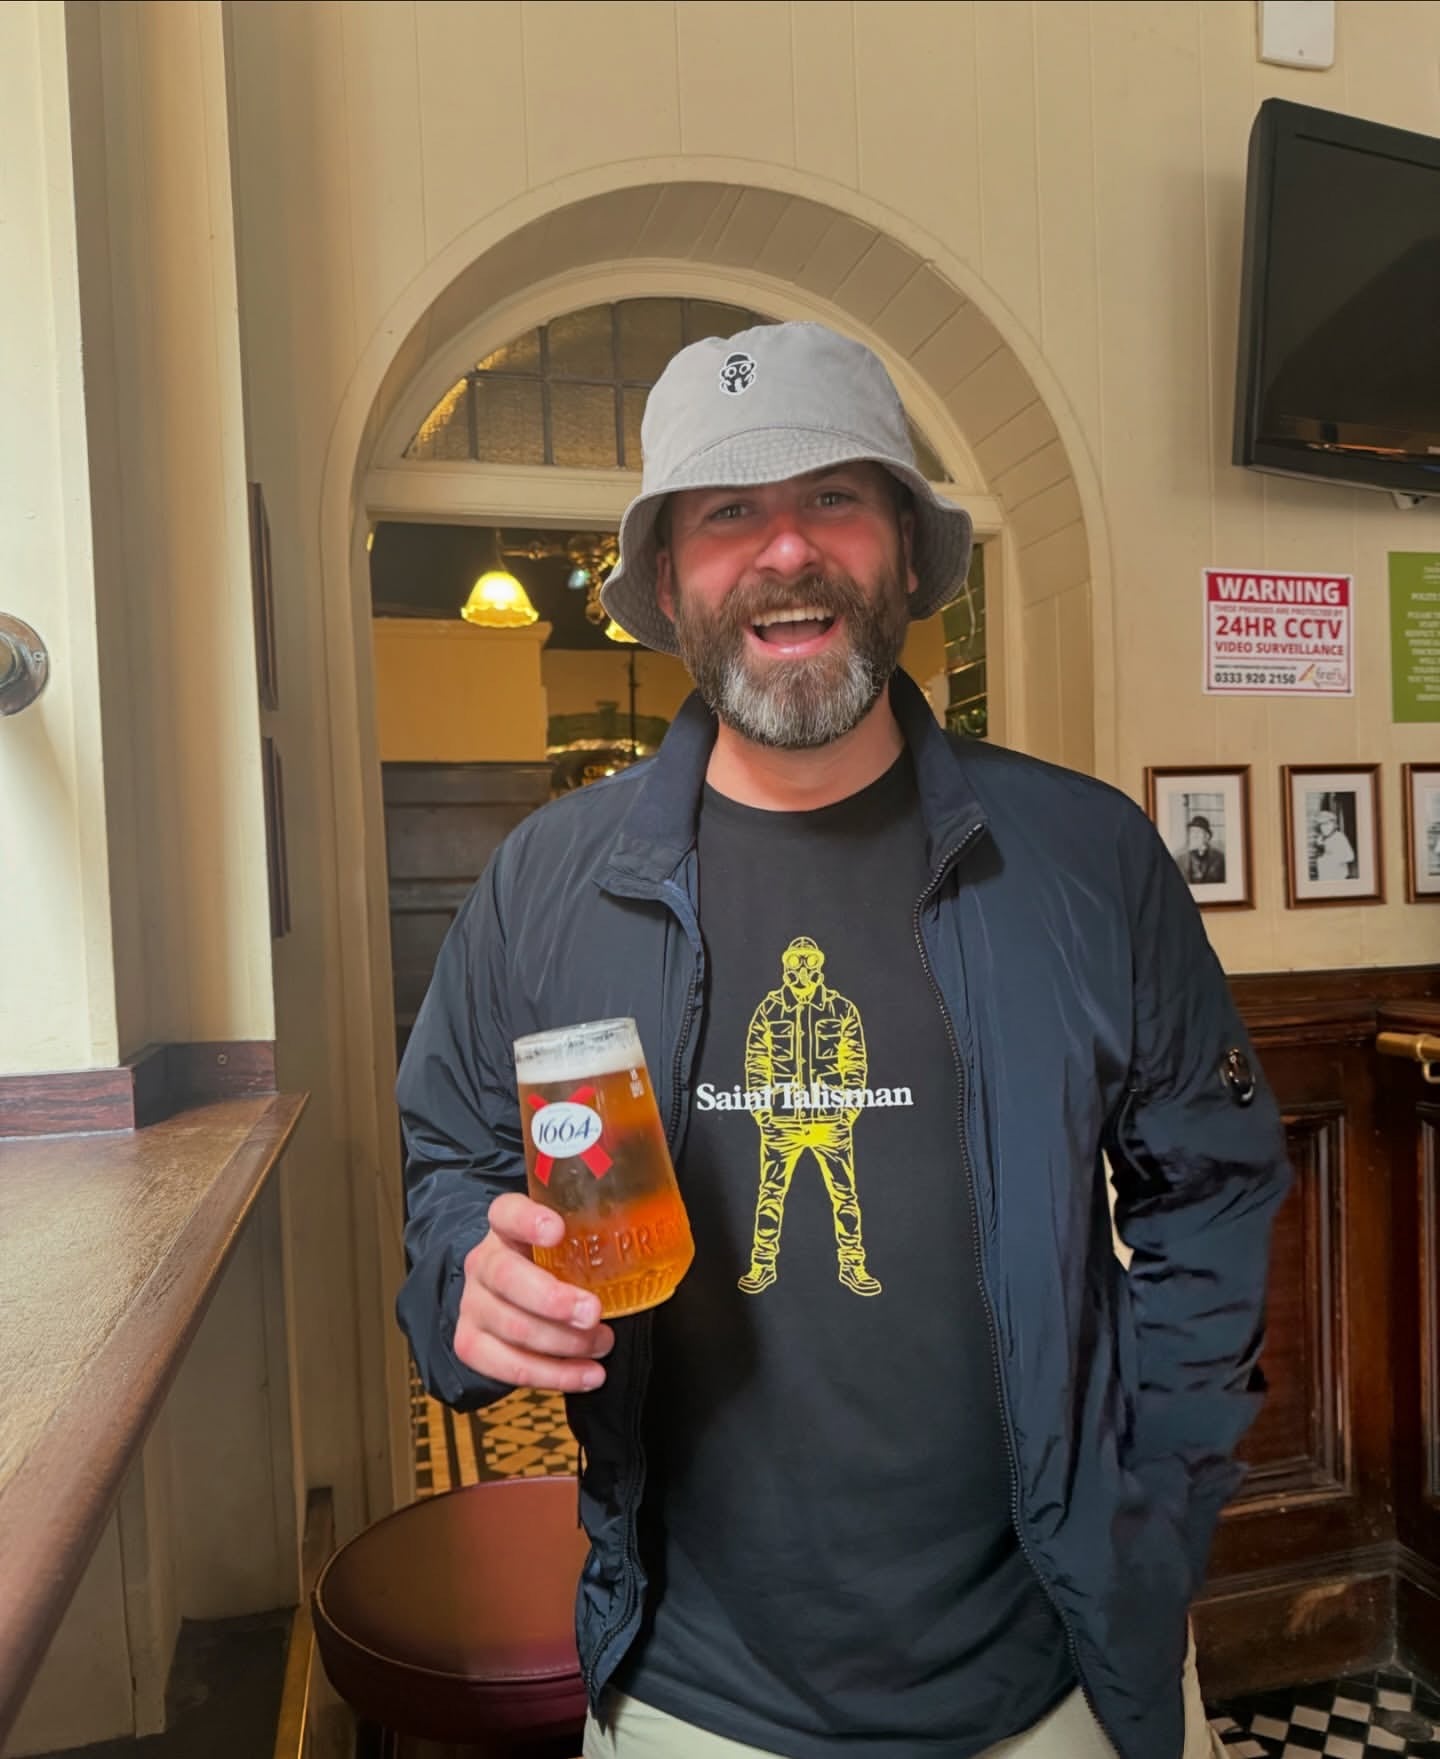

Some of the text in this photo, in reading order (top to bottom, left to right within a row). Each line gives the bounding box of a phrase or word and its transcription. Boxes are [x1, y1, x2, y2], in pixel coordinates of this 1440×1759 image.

[1216, 577, 1340, 604] WARNING
[1216, 615, 1343, 640] 24HR CCTV
[1216, 641, 1345, 656] VIDEO SURVEILLANCE
[1215, 672, 1297, 685] 0333 920 2150
[696, 1081, 914, 1111] Saint Talisman
[538, 1114, 592, 1145] 1664
